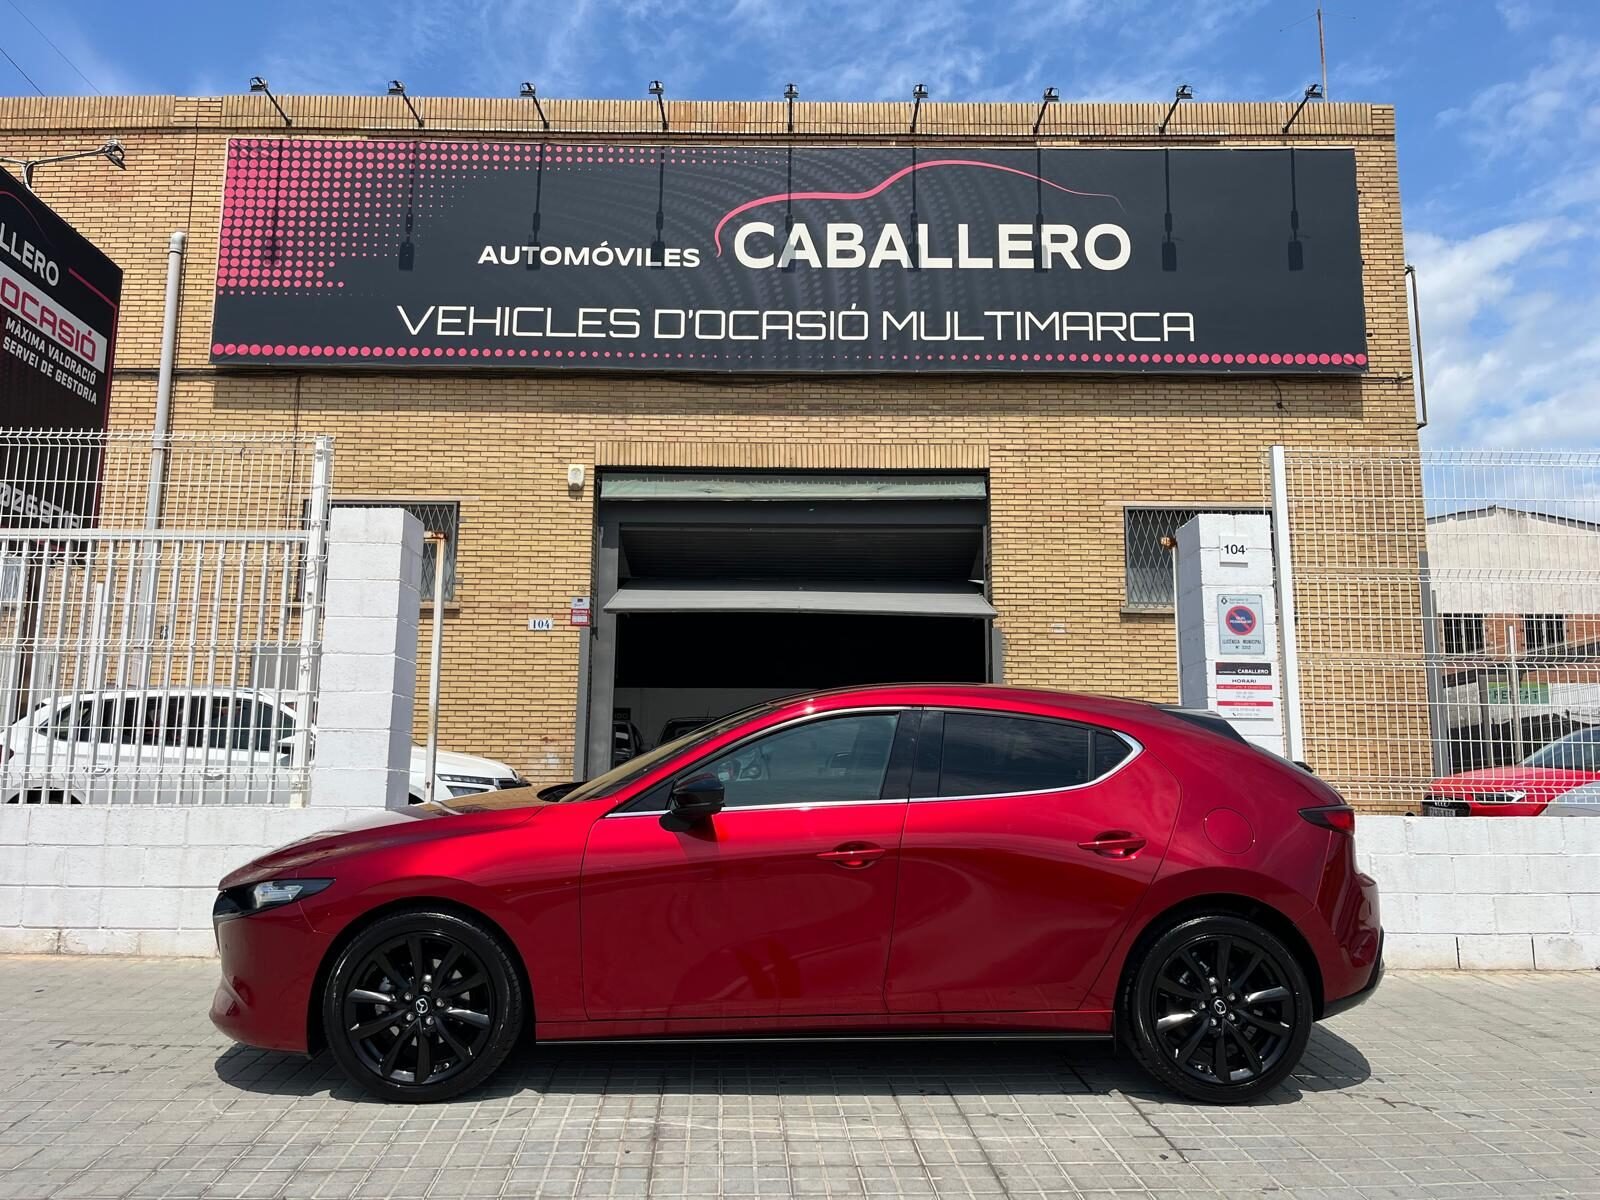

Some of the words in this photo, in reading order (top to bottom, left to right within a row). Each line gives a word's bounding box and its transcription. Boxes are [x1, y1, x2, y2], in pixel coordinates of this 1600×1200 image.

[478, 241, 700, 267] AUTOMÓVILES
[734, 222, 1131, 270] CABALLERO
[0, 277, 97, 362] OCASIÓ
[396, 305, 640, 339] VEHICLES
[654, 303, 869, 341] D'OCASIÓ
[882, 310, 1195, 342] MULTIMARCA
[3, 336, 39, 369] SERVEI
[40, 360, 54, 378] DE
[55, 369, 97, 405] GESTORIA
[48, 343, 97, 386] VALORACIÓ
[1224, 544, 1246, 555] 104
[533, 619, 550, 629] 104
